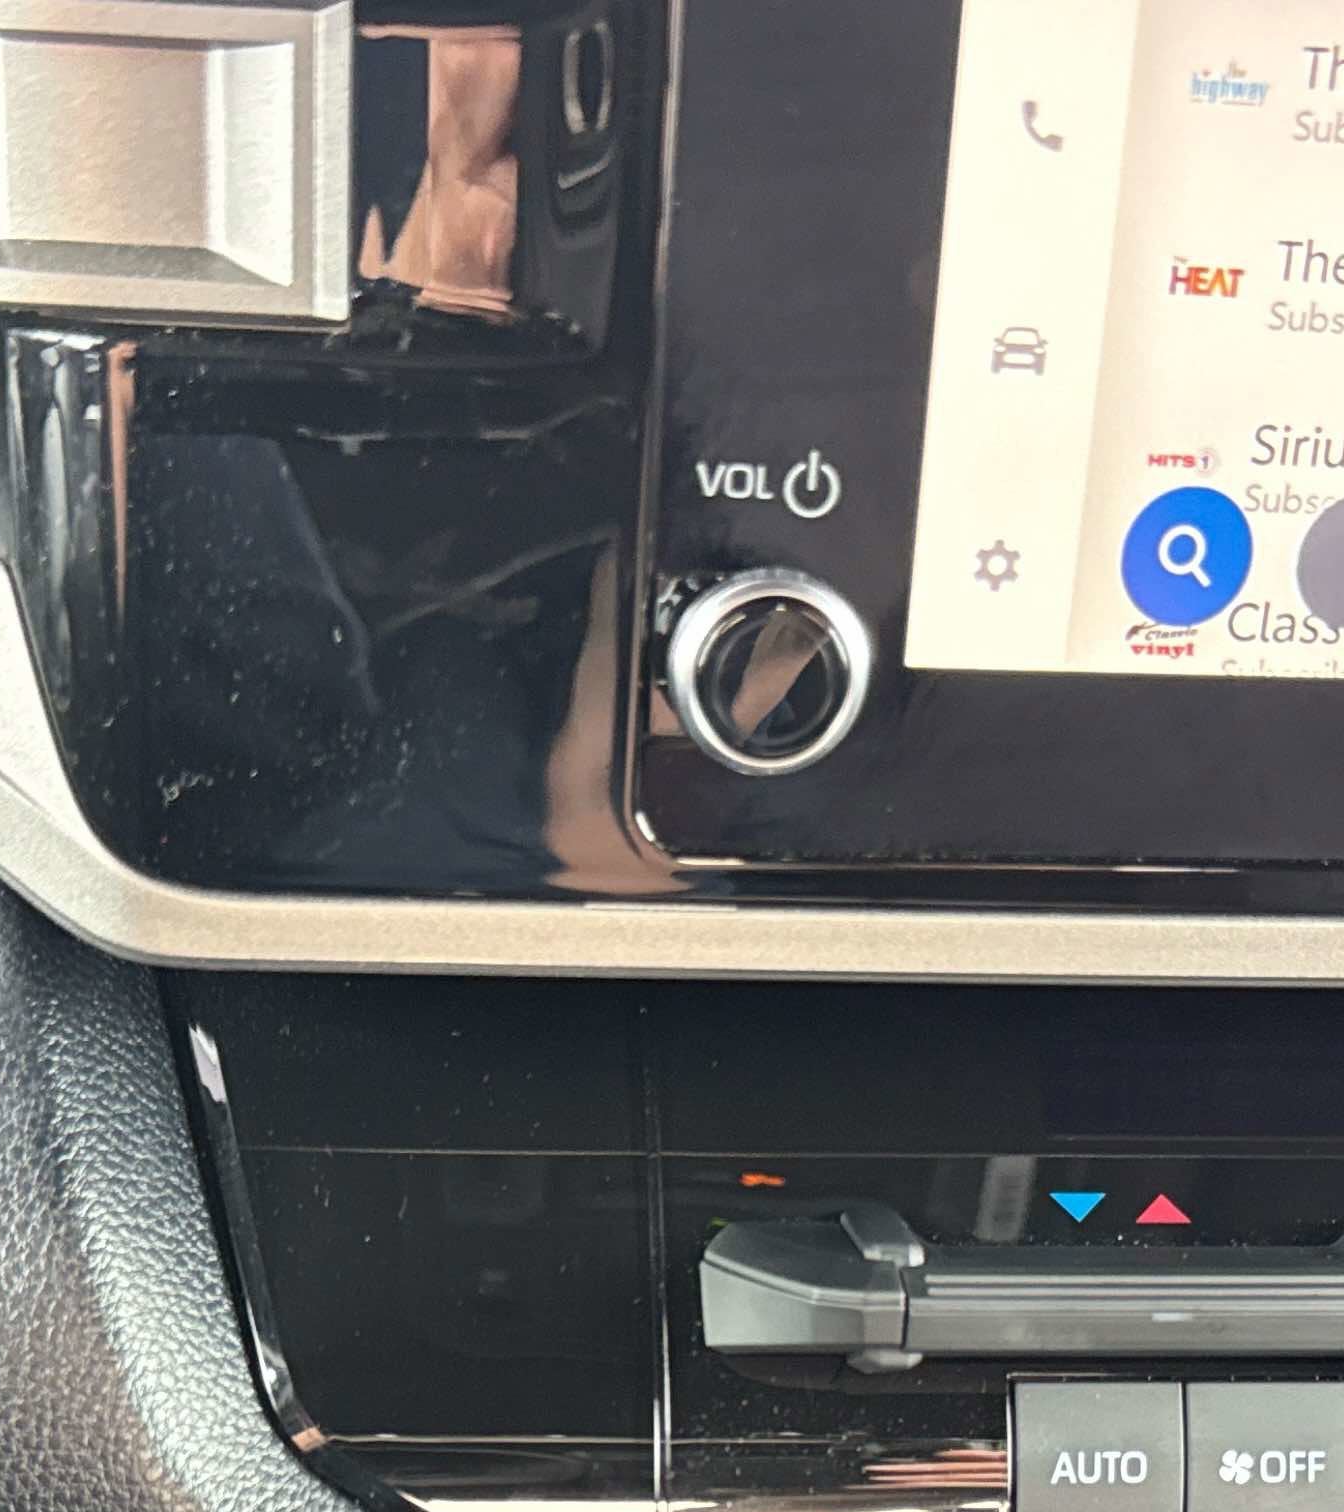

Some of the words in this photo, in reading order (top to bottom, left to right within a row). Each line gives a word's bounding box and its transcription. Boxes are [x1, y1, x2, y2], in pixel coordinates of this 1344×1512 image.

[1168, 265, 1244, 298] HEAT
[1147, 452, 1195, 469] HITS
[695, 460, 774, 500] VOL
[1050, 1450, 1147, 1485] AUTO
[1259, 1450, 1327, 1485] OFF
